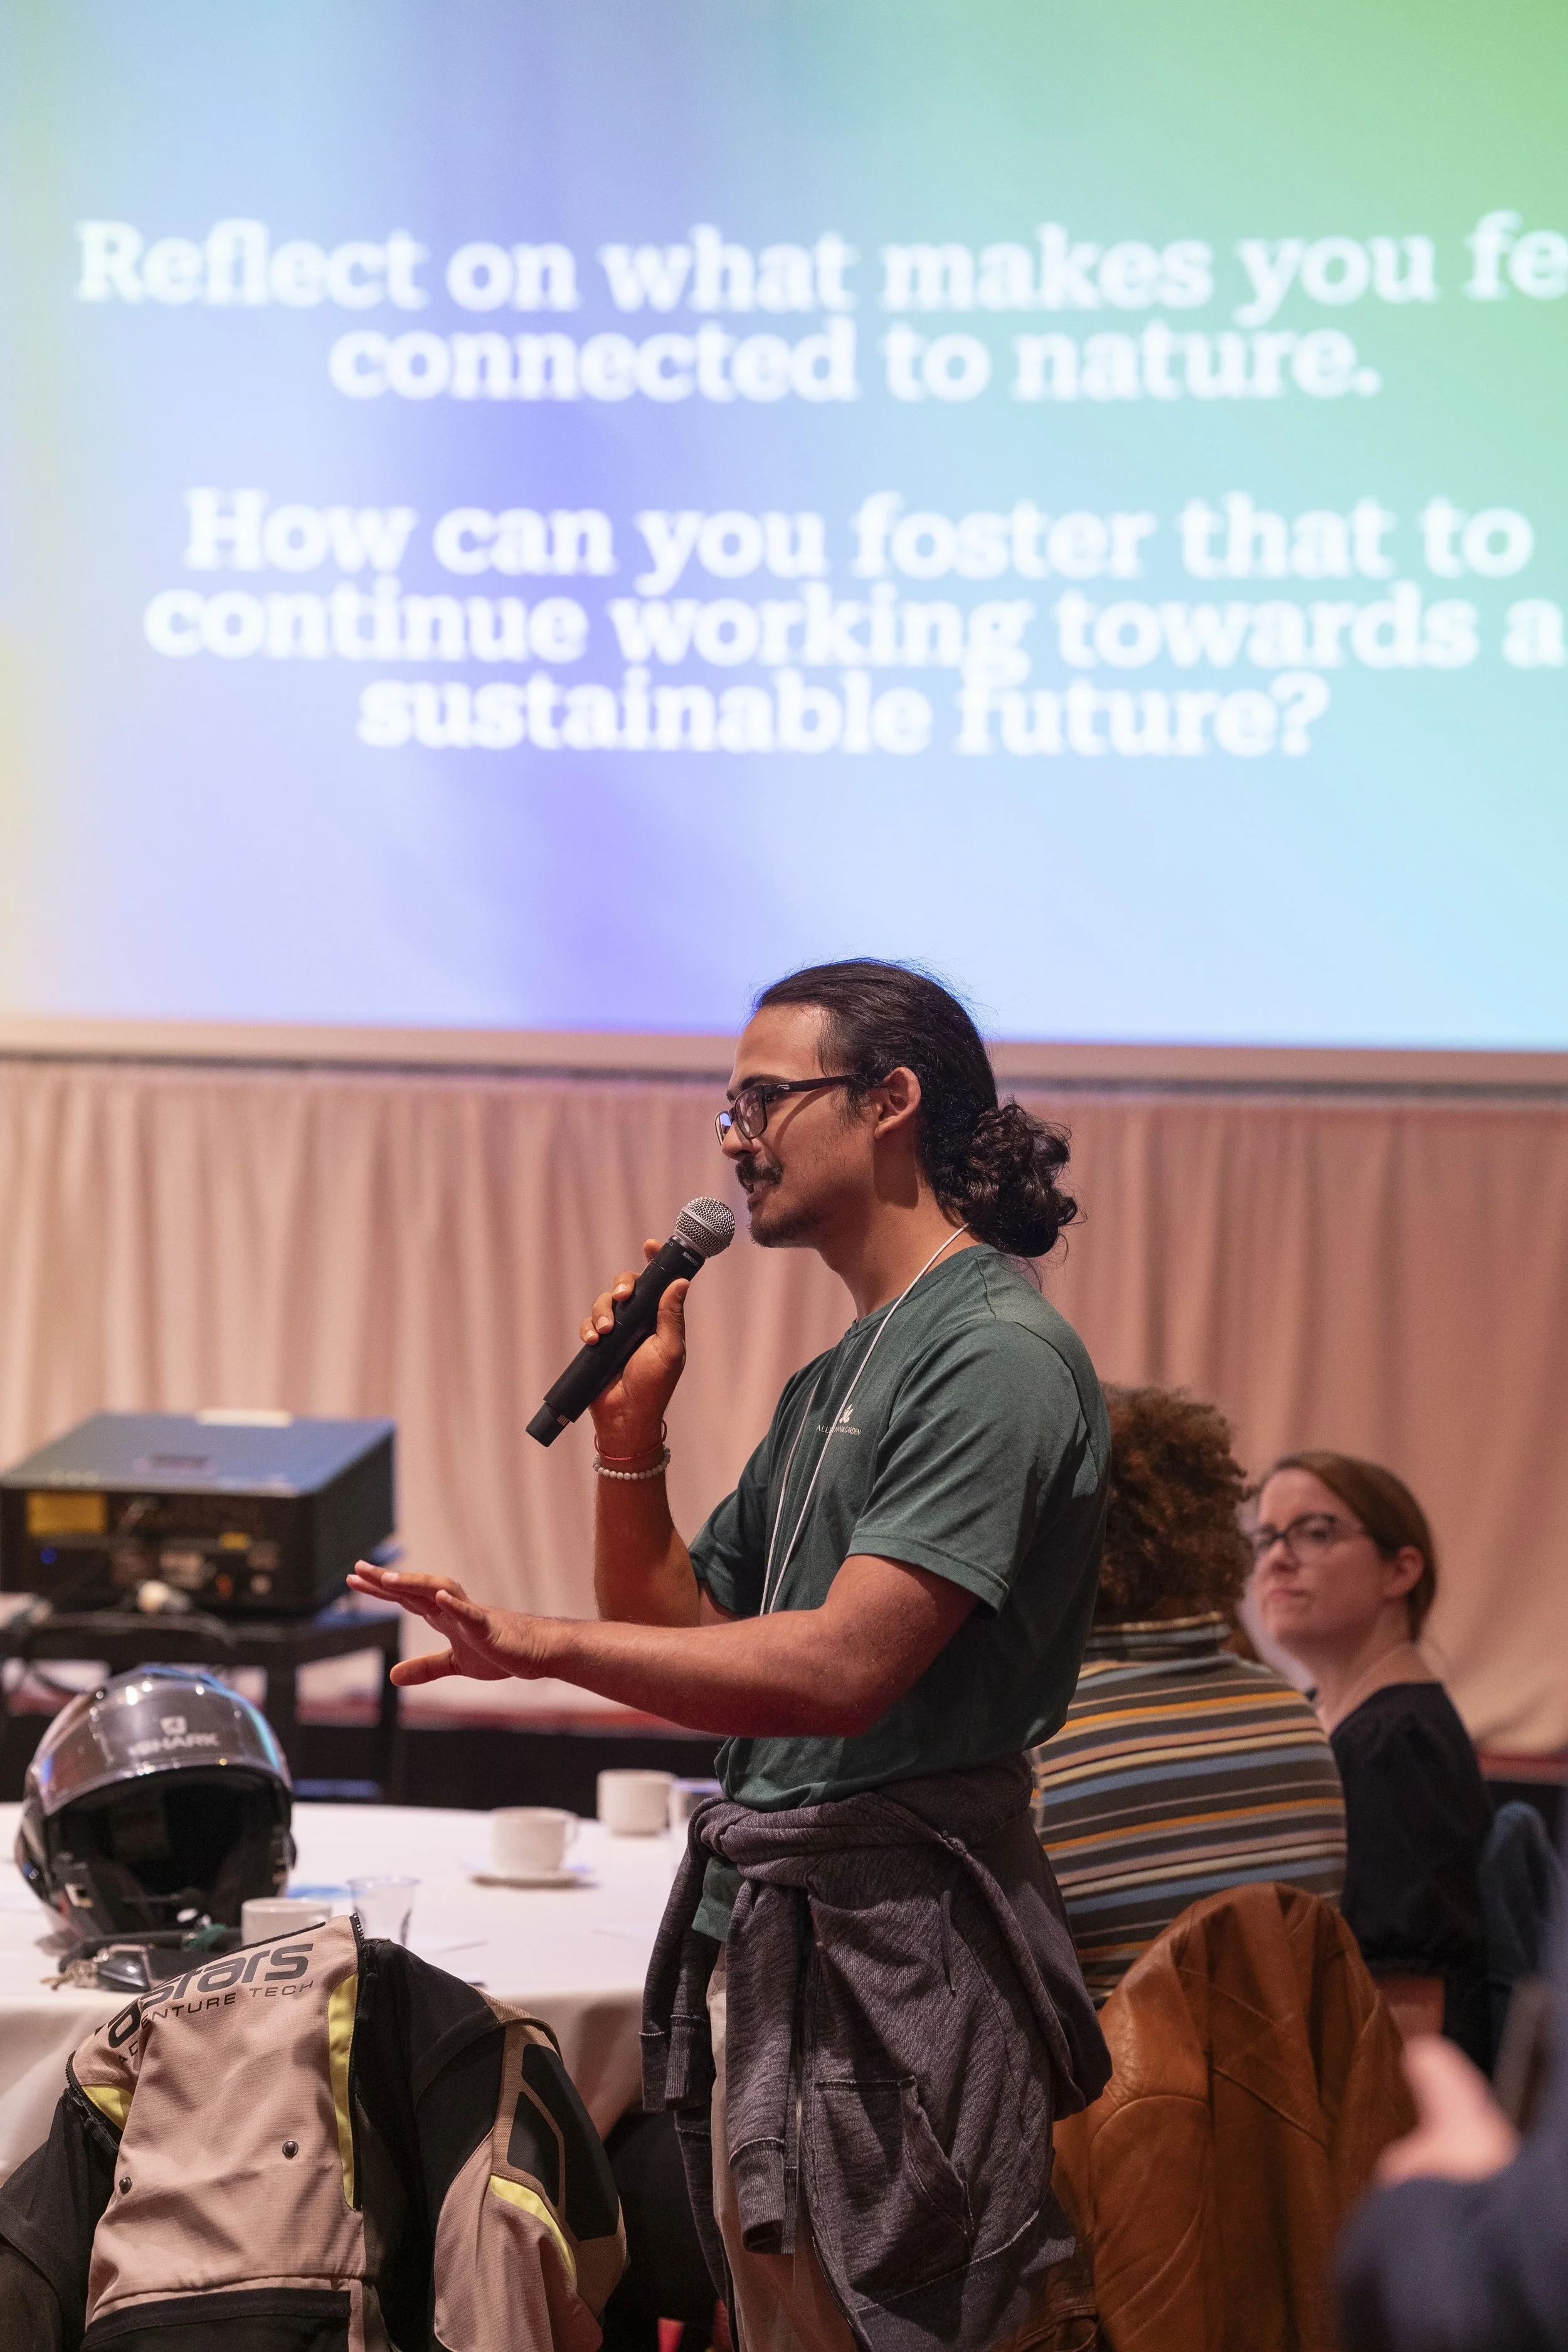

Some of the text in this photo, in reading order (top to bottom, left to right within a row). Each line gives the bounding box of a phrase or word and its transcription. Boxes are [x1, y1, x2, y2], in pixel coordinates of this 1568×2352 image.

[78, 218, 428, 307] Reflect
[446, 241, 580, 312] on
[599, 223, 856, 312] what
[879, 221, 1214, 311] makes
[1233, 235, 1440, 328] you
[329, 312, 1381, 403] connected to nature.
[184, 486, 1535, 596] How can you foster that to
[143, 574, 1568, 689] continue working towards a
[357, 665, 1331, 757] sustainable future?
[248, 1980, 314, 1998] TECH
